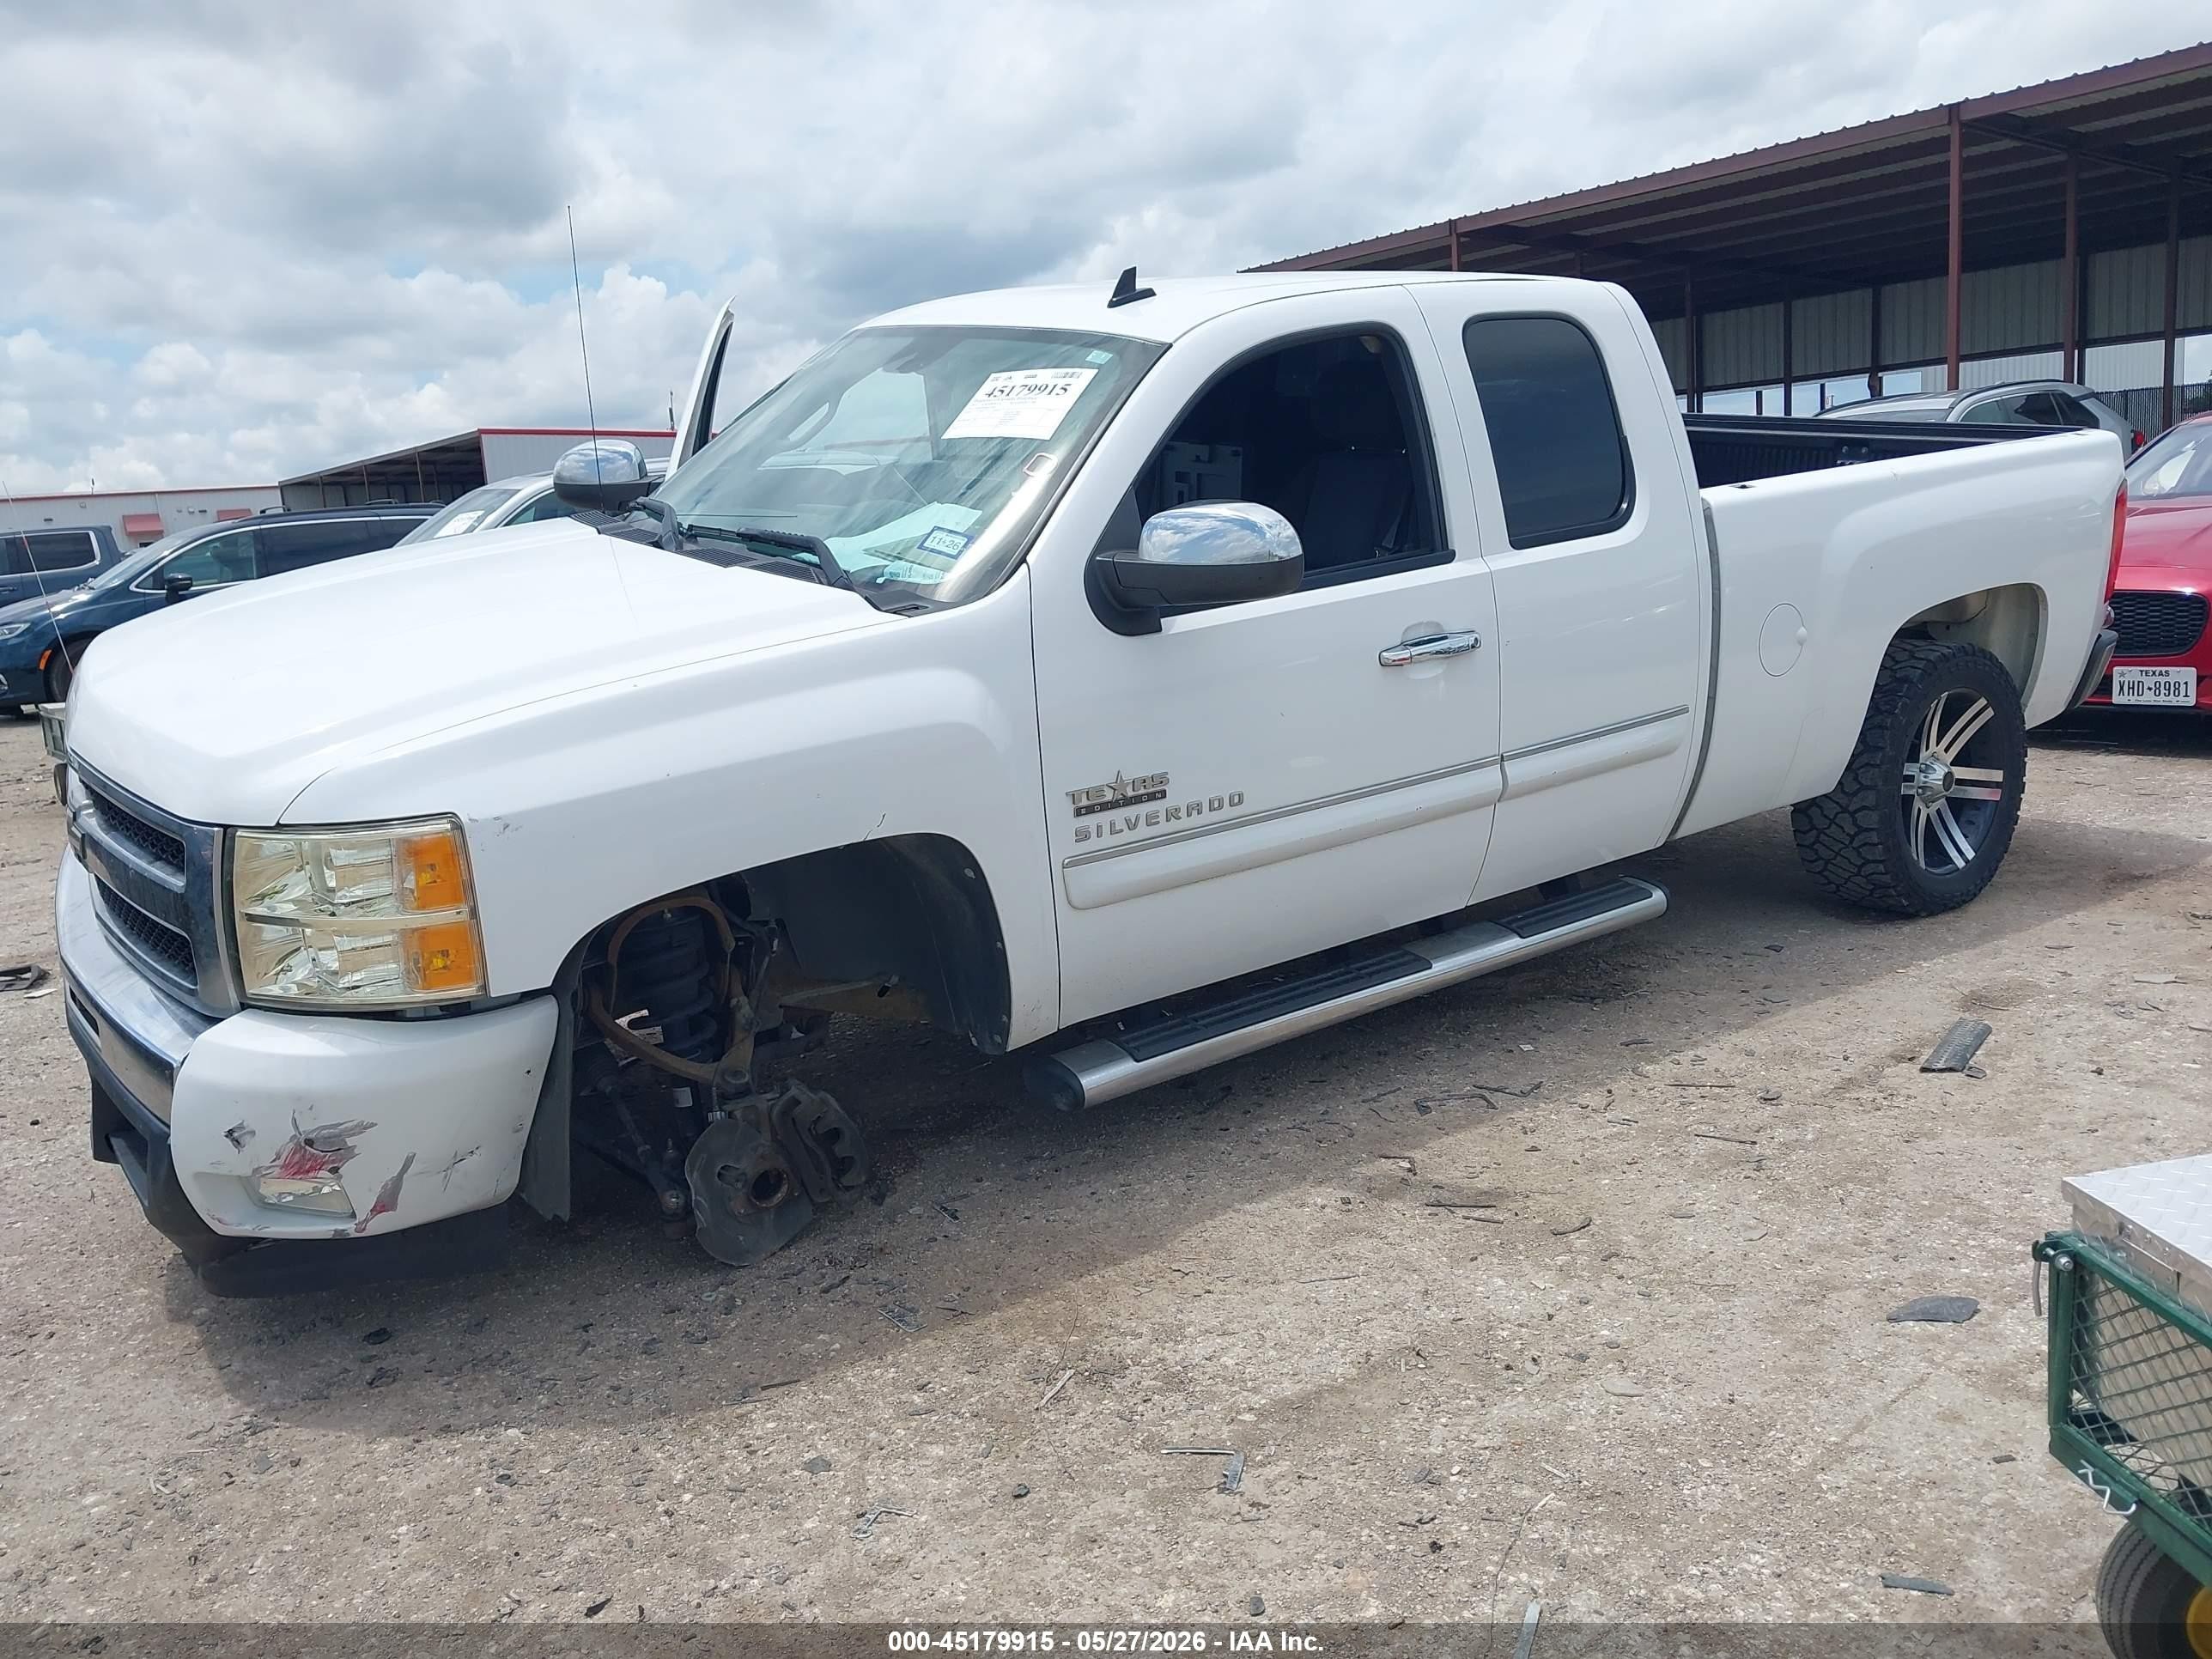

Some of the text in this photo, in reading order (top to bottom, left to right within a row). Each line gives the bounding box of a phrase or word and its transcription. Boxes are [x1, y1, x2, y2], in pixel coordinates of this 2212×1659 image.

[984, 383, 1073, 398] 45179915
[1079, 792, 1163, 815] EDITION
[1074, 790, 1244, 843] SILVERADO
